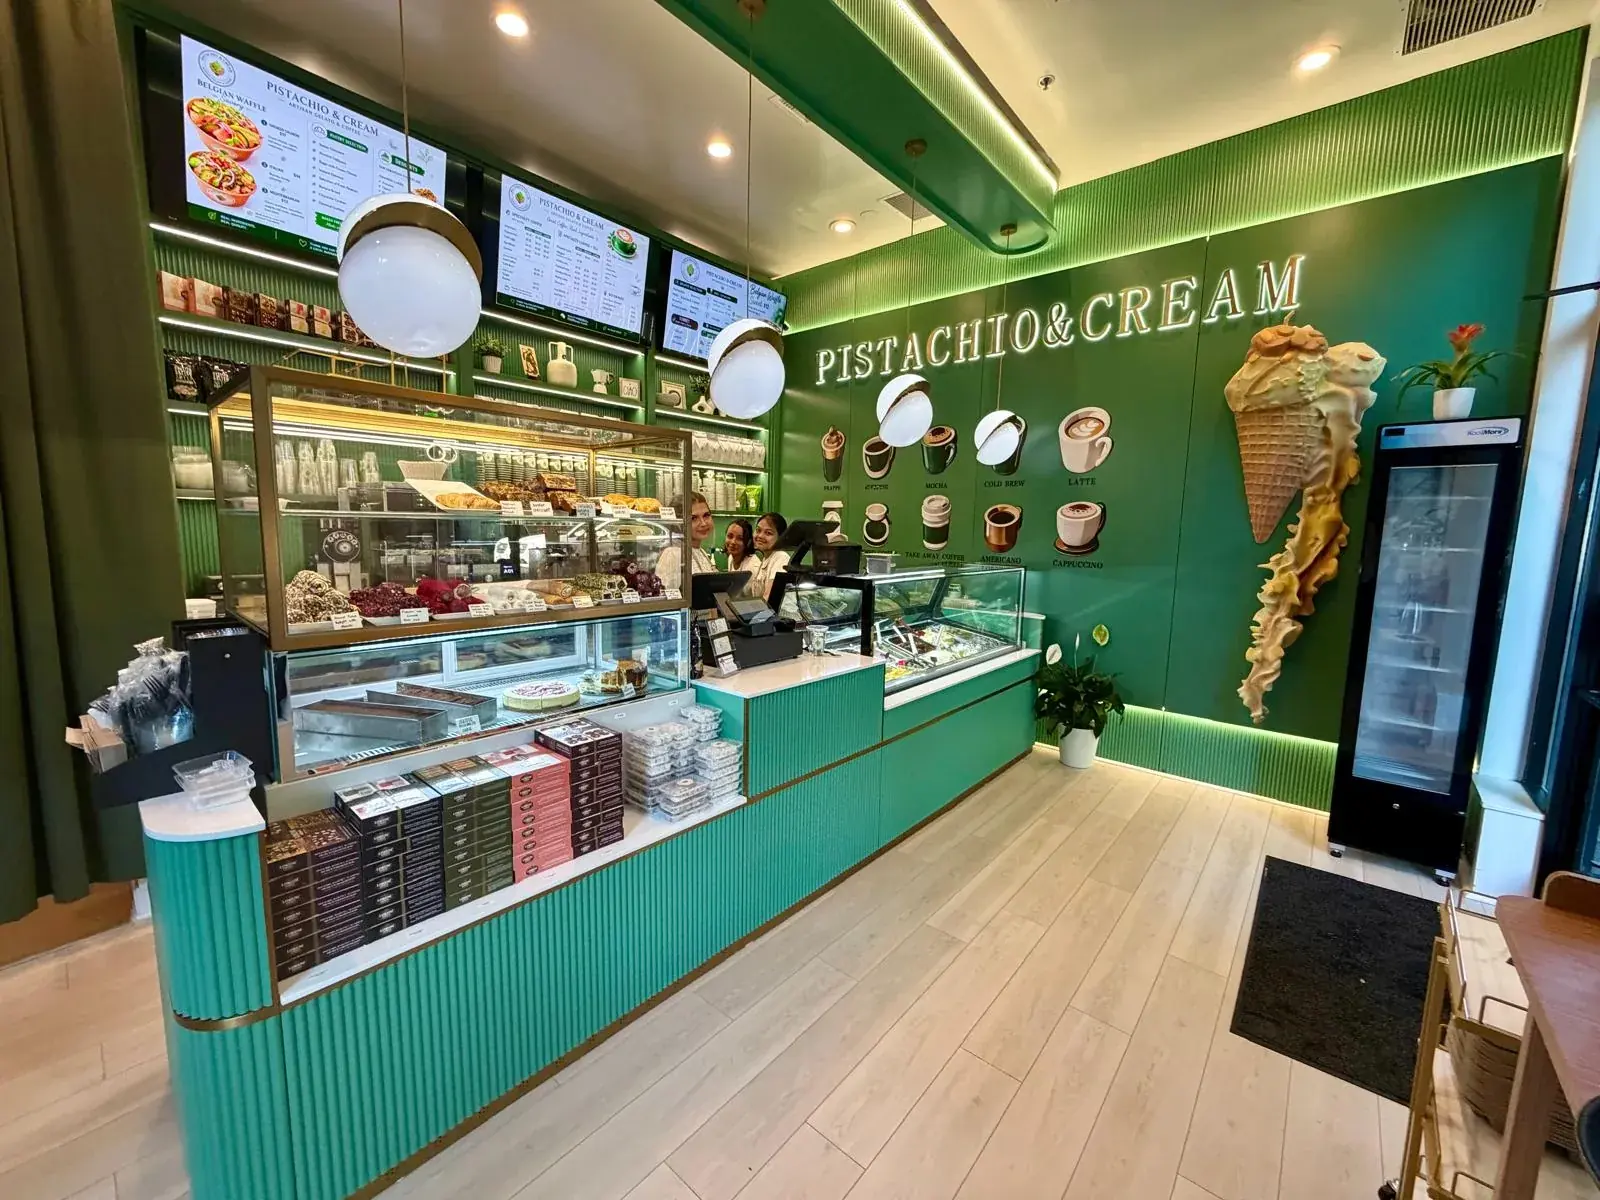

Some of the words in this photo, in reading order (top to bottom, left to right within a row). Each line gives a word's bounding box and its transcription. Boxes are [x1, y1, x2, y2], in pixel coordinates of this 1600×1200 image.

[197, 78, 234, 98] BELGIAN
[266, 81, 329, 115] PISTACHIO
[332, 110, 340, 120] &
[343, 114, 378, 136] CREAM
[540, 198, 575, 217] PISTACHIO
[581, 215, 604, 231] CREAM
[984, 480, 1002, 488] COLD
[1004, 479, 1025, 488] BREW
[1068, 478, 1097, 486] LATTE
[905, 551, 920, 559] TAKE
[922, 552, 941, 560] AWAY
[981, 555, 1022, 565] AMERICANO
[1052, 559, 1104, 569] CAPPUCCINO
